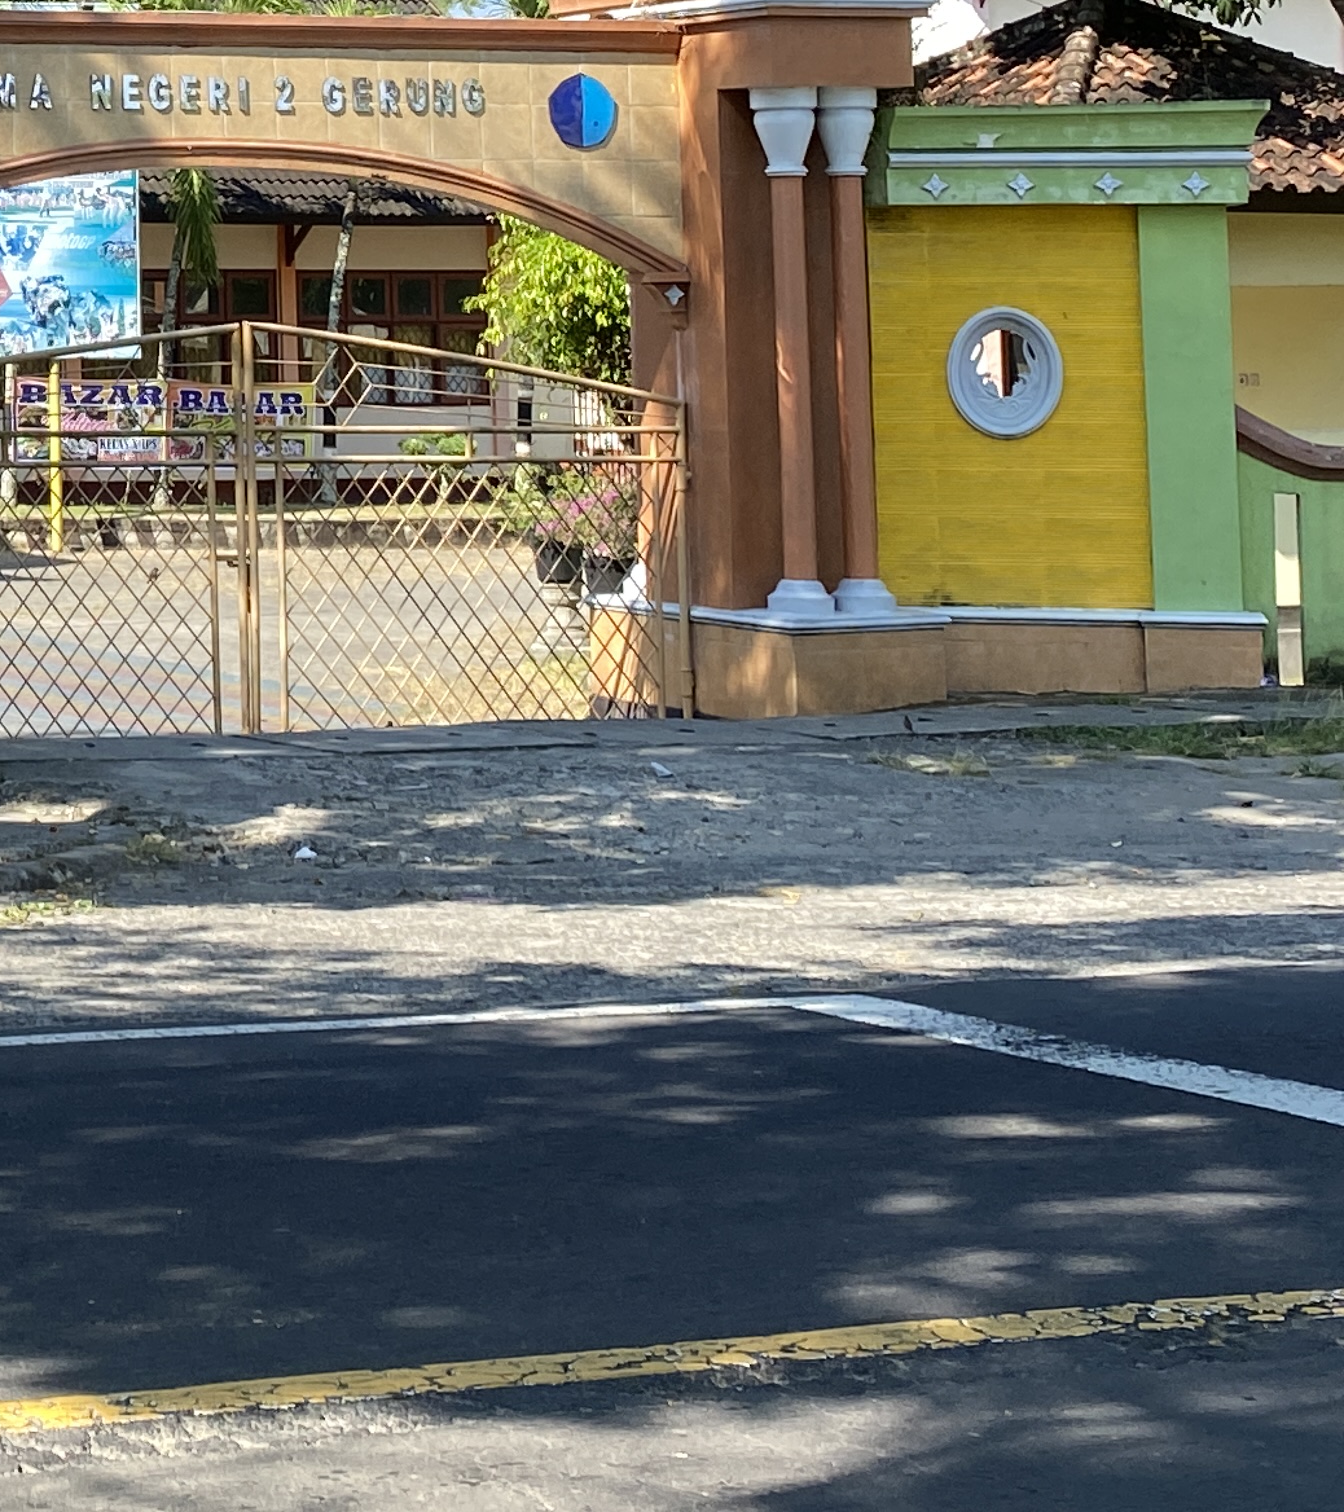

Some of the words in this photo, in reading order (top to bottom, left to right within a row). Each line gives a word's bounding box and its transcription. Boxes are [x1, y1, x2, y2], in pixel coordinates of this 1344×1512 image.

[90, 74, 251, 115] NEGERI
[274, 76, 296, 115] 2
[322, 76, 486, 116] GERUNG
[19, 384, 163, 405] BAZAR
[179, 390, 305, 414] BAAR
